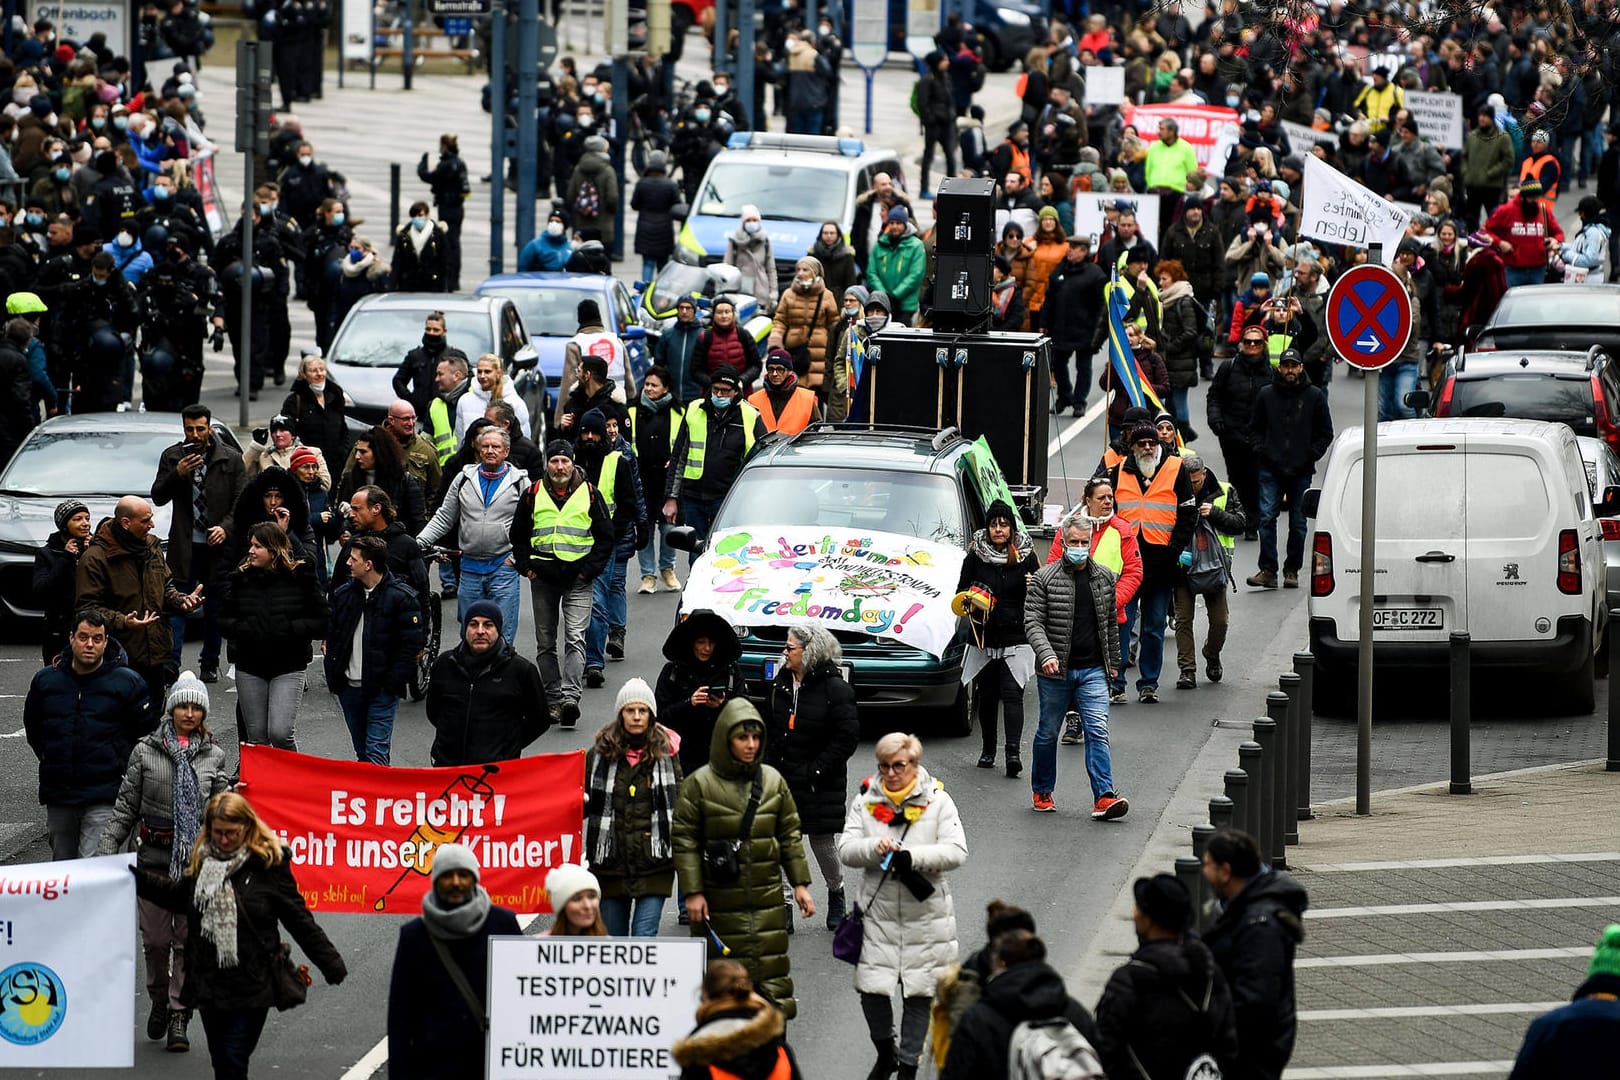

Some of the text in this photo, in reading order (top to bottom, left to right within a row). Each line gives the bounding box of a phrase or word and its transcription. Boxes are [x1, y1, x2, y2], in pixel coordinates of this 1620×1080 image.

[733, 587, 924, 633] Freedomday!
[1374, 611, 1436, 625] OF C 272
[331, 791, 366, 825] Es
[537, 945, 658, 965] NILPFERDE
[517, 976, 656, 997] TESTPOSITIV
[530, 1015, 661, 1036] IMPFZWANG
[501, 1042, 669, 1069] FÜR WILDTIERE
